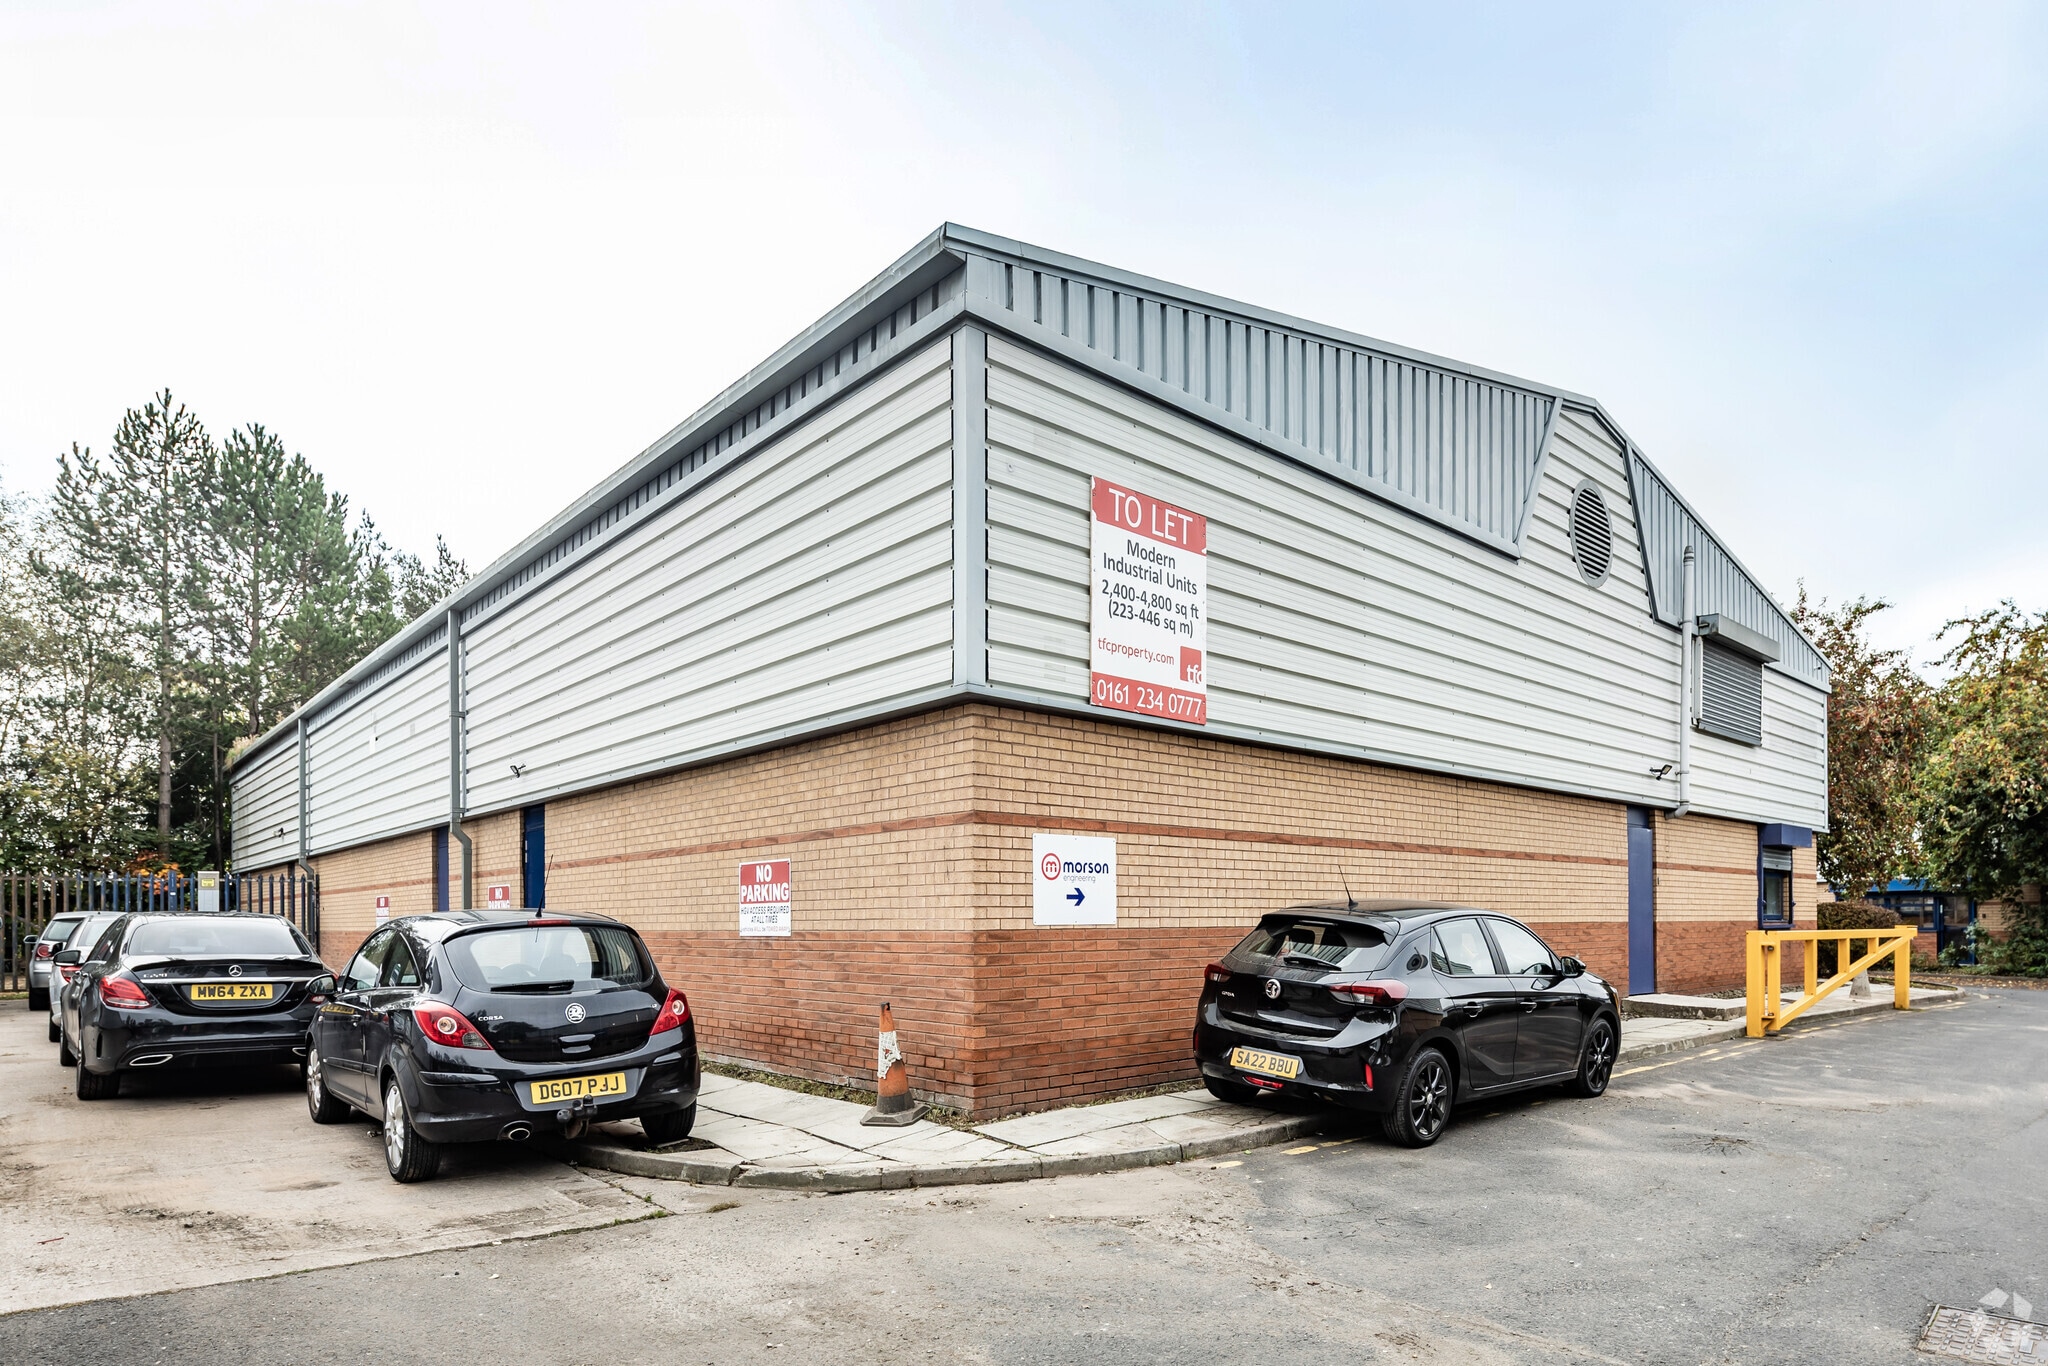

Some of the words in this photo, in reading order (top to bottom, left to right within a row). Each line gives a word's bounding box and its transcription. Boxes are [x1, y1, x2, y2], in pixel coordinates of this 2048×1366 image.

[1108, 487, 1143, 529] TO
[1151, 503, 1193, 545] LET
[1126, 538, 1176, 570] Modern
[1103, 552, 1163, 585] Industrial
[1166, 571, 1198, 595] Units
[1101, 578, 1172, 612] 2,400-4,800
[1175, 602, 1187, 620] sq
[1190, 603, 1199, 620] ft
[1108, 598, 1161, 627] (223-446
[1163, 616, 1176, 635] sq
[1179, 619, 1194, 639] m)
[1097, 636, 1175, 666] tfcproperty.com
[1096, 678, 1129, 705] 0161
[1136, 686, 1164, 711] 234
[1168, 692, 1202, 718] 0777
[756, 864, 772, 882] NO
[1063, 861, 1109, 874] morson
[1063, 875, 1096, 883] engineering
[741, 882, 789, 902] PARKING
[750, 905, 766, 915] ACCESS
[767, 905, 789, 915] REQUIRED
[197, 985, 236, 998] MW64
[239, 985, 267, 998] ZXA
[1236, 1051, 1266, 1068] SA22
[1268, 1056, 1293, 1075] BBU
[538, 1079, 583, 1100] DG07
[587, 1075, 620, 1094] PJJ
